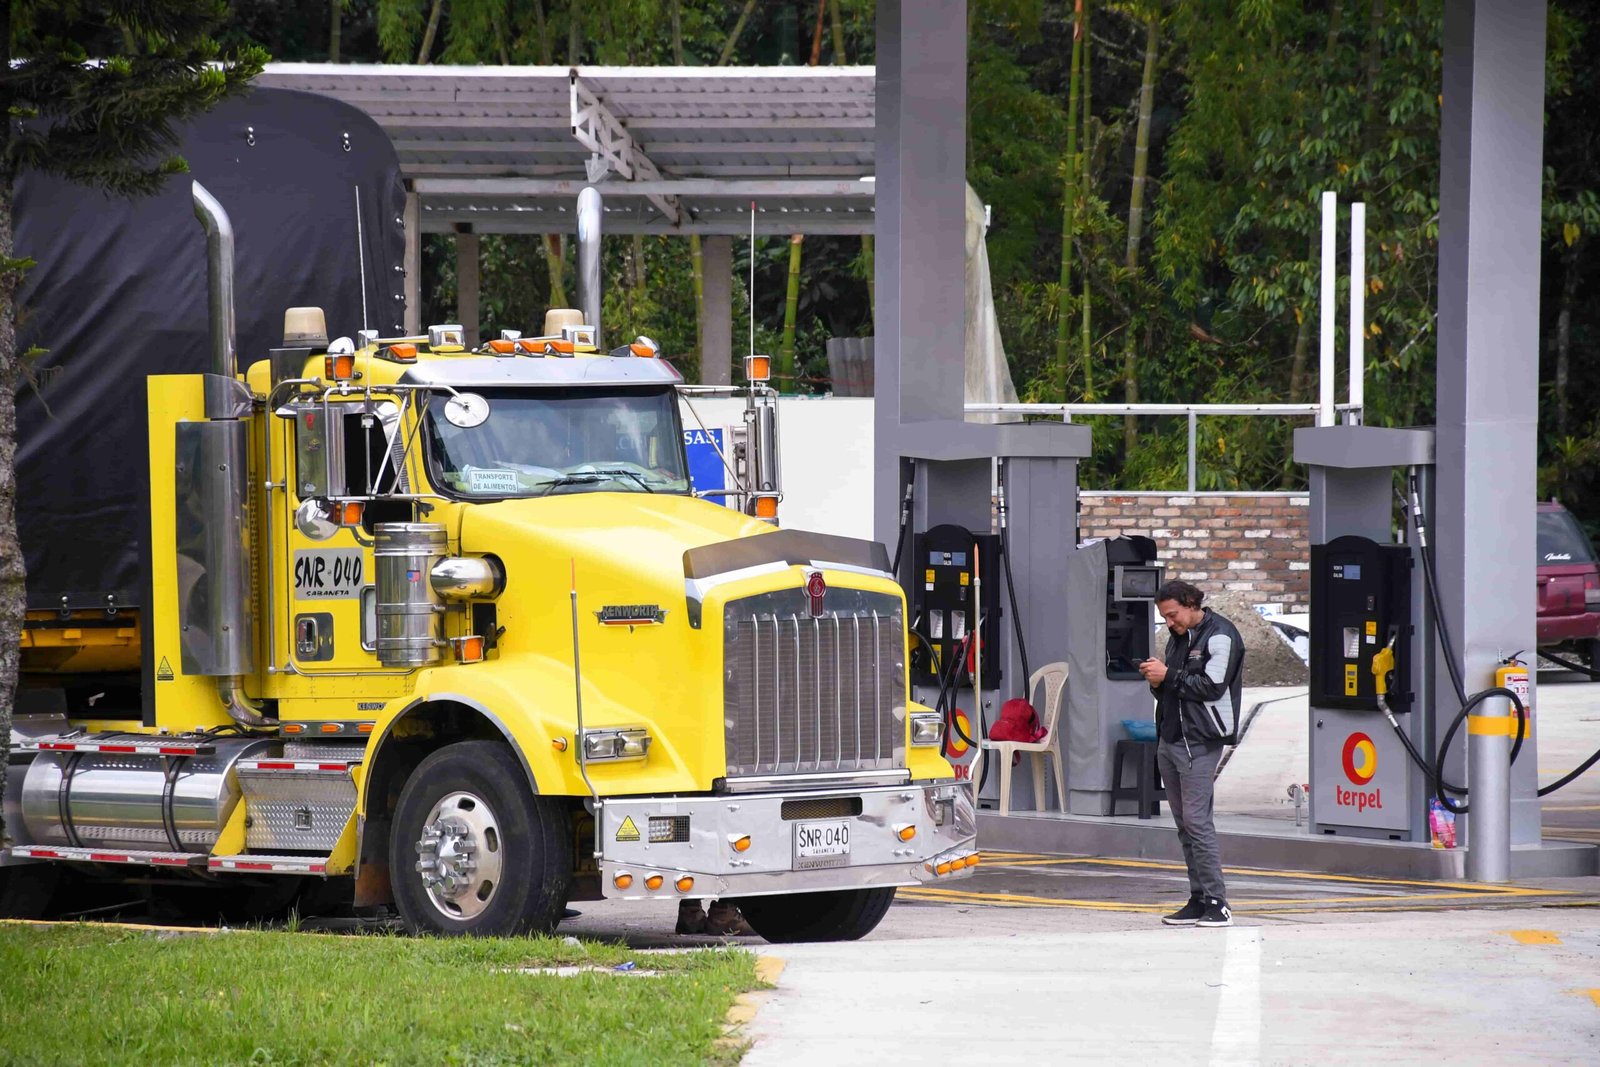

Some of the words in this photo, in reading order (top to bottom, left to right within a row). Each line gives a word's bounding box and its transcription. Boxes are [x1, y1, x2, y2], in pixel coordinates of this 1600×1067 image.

[684, 430, 720, 445] SAS.
[474, 473, 514, 481] TRANSPORTE
[484, 483, 517, 491] ALIMENTOS
[603, 605, 659, 617] KENWORTH
[357, 702, 386, 711] KENWO
[1336, 785, 1383, 813] terpel
[799, 828, 822, 848] SNR
[825, 827, 849, 846] 040
